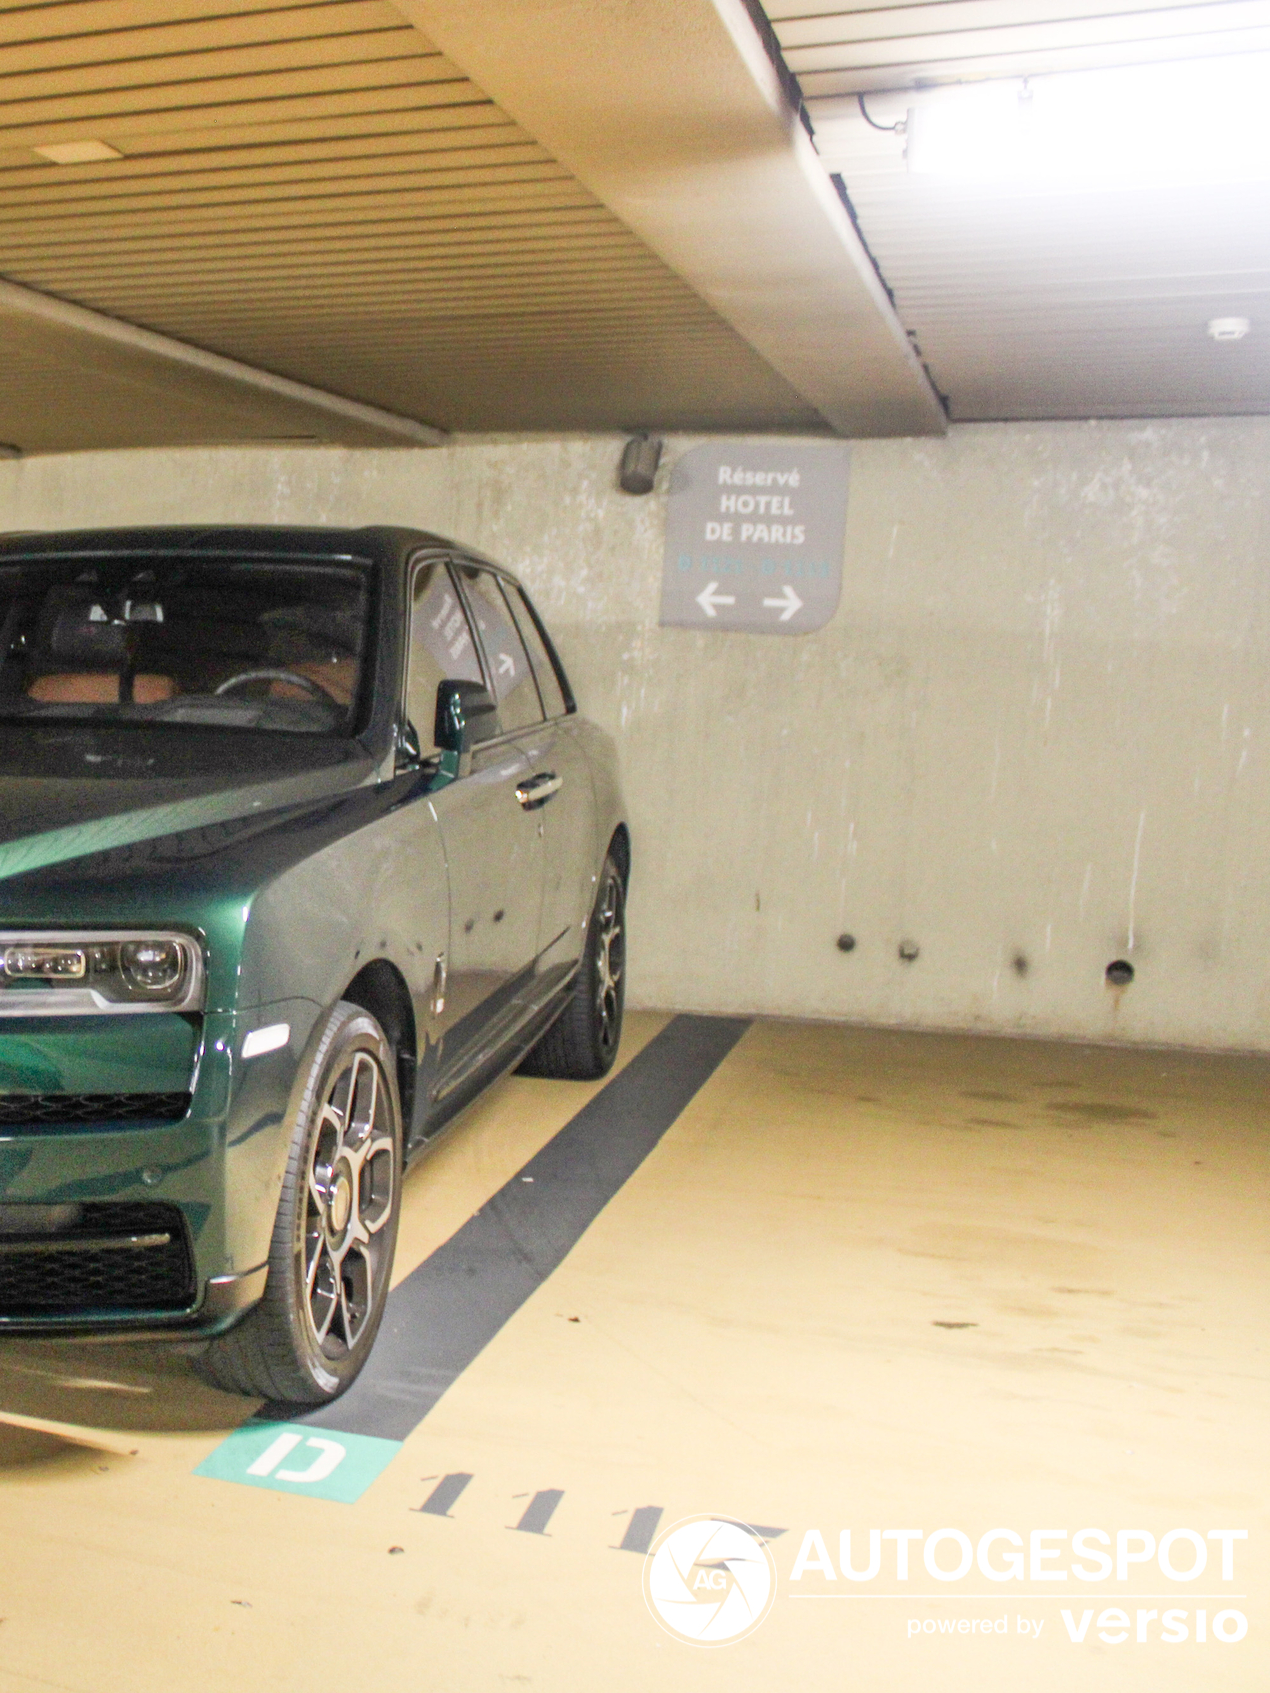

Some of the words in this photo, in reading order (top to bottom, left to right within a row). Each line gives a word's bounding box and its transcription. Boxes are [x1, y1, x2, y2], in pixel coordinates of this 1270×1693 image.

[718, 465, 801, 489] Réservé
[720, 494, 795, 516] HOTEL
[704, 521, 733, 543] DE
[739, 523, 806, 545] PARIS
[246, 1432, 347, 1484] D
